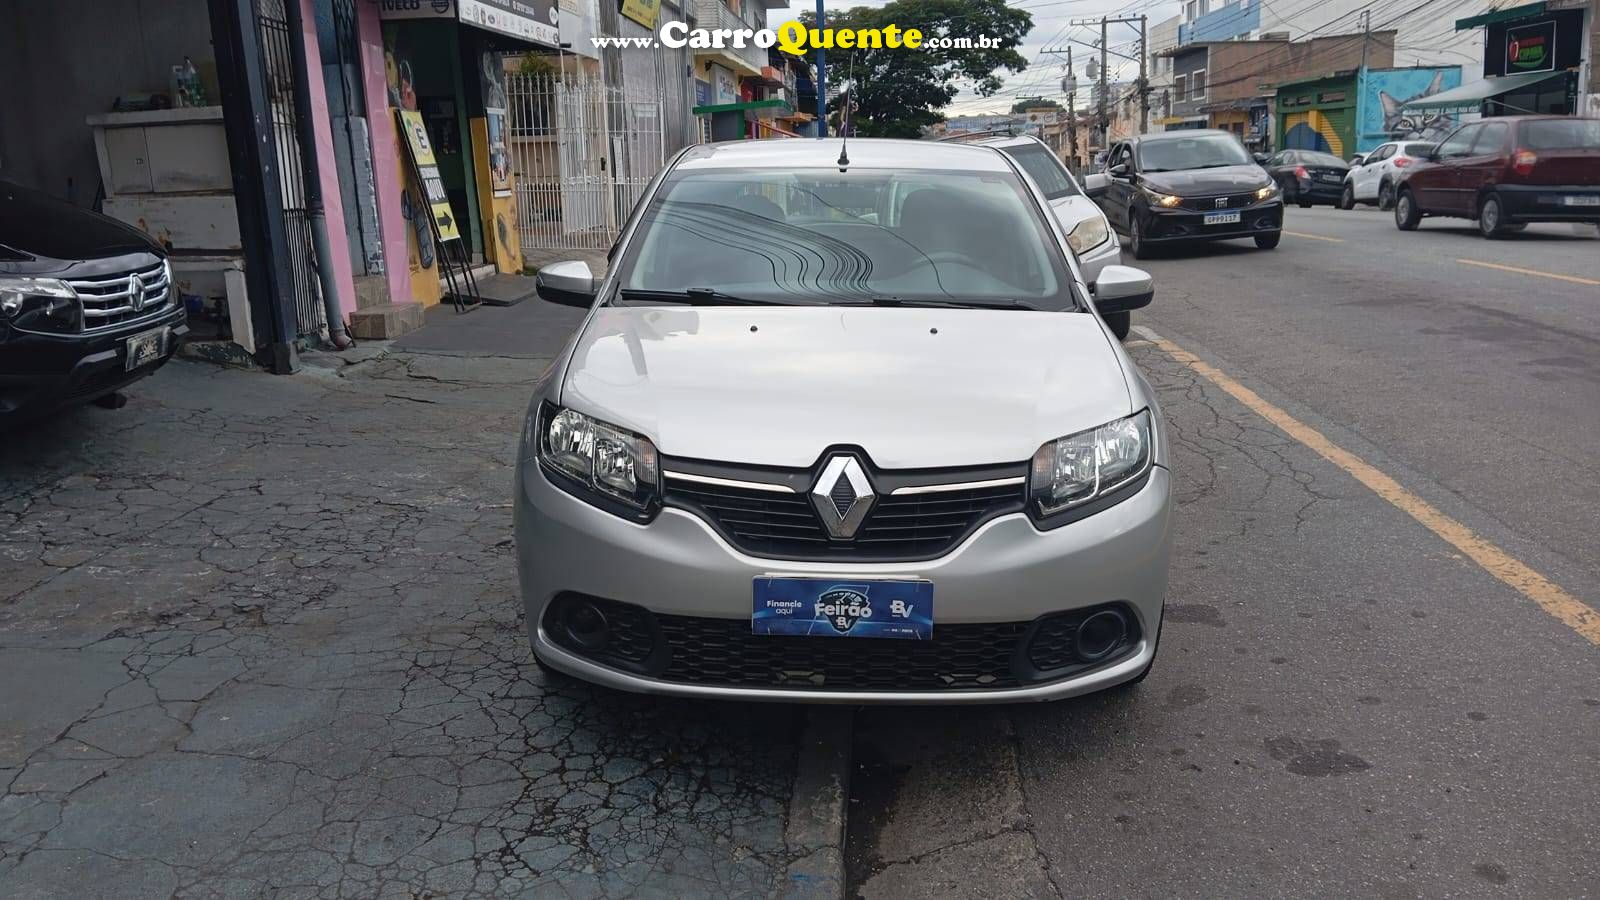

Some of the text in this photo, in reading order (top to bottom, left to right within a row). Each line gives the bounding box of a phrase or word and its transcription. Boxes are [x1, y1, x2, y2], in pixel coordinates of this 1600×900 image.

[766, 600, 802, 608] Financie
[814, 601, 872, 618] Feirão
[889, 600, 913, 618] BV
[775, 607, 793, 615] aqui
[835, 616, 852, 629] BV
